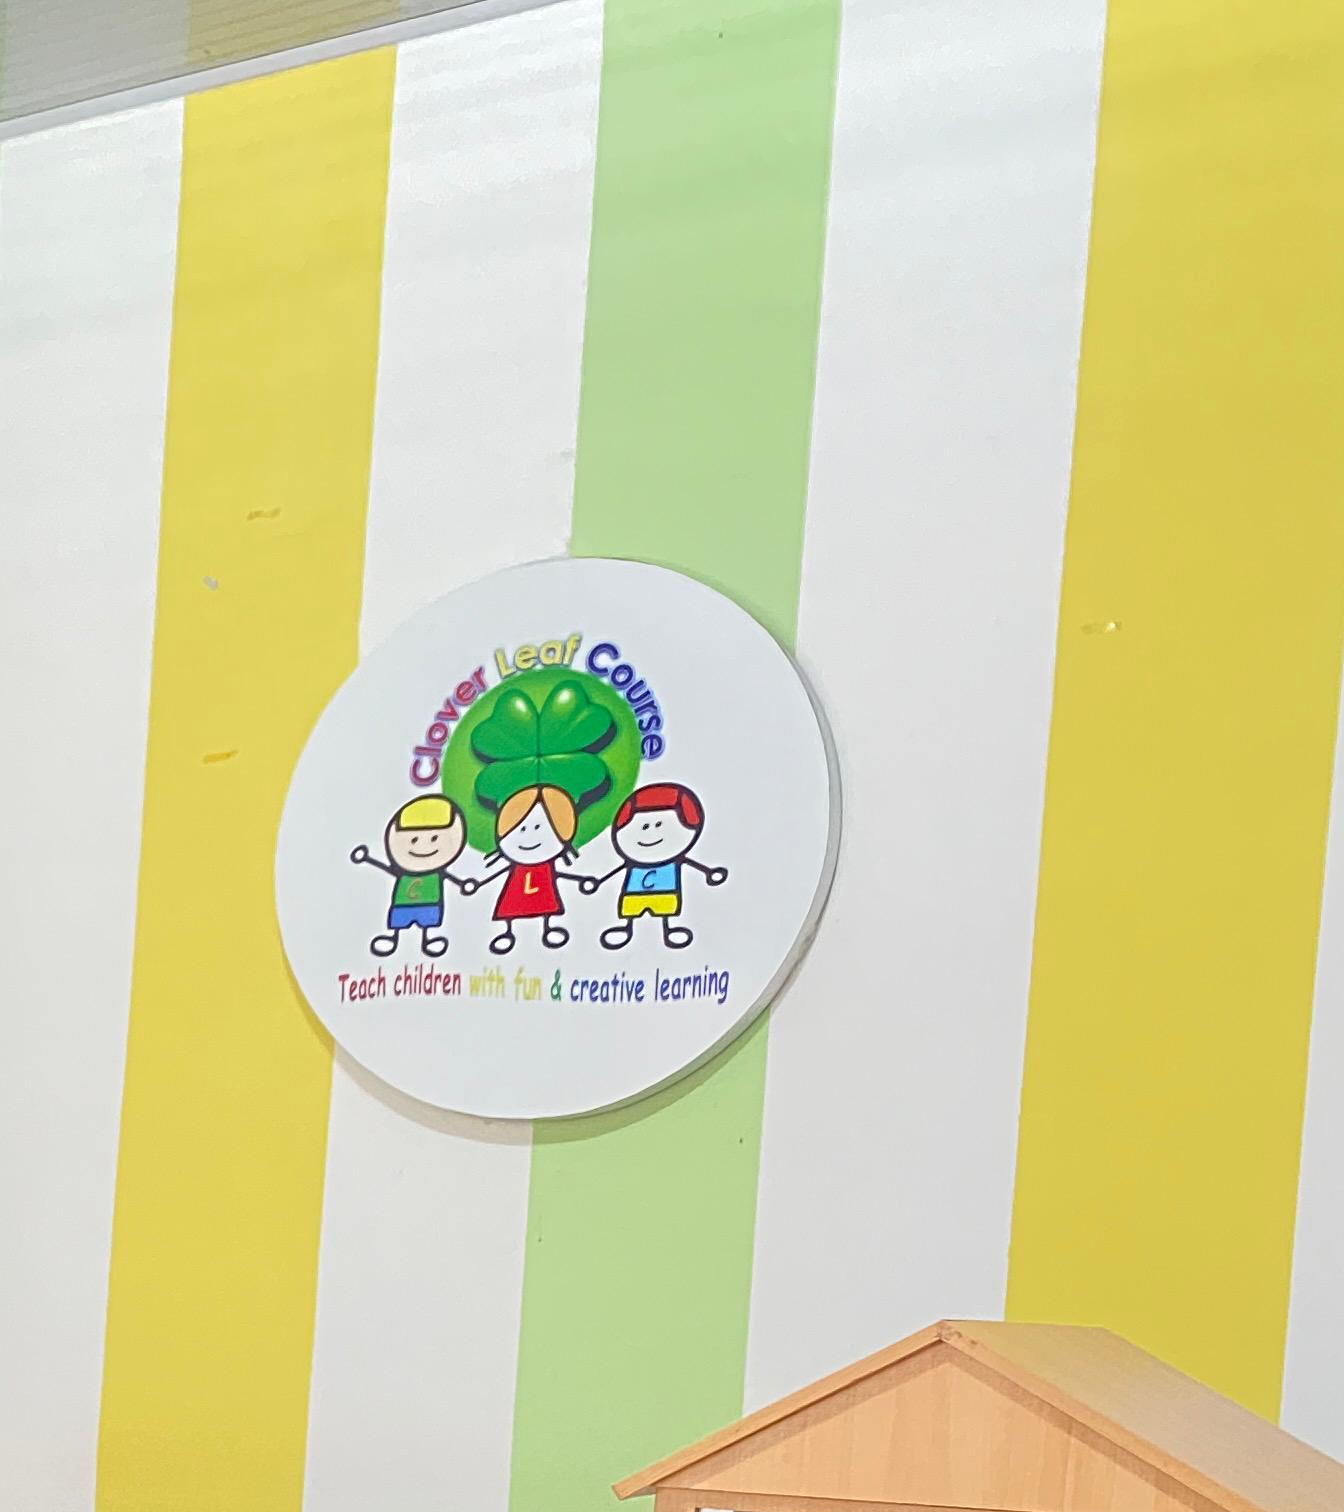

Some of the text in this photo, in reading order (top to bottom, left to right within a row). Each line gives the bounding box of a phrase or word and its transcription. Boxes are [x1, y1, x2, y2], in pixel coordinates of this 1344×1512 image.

[410, 633, 665, 787] Clover Leaf Course
[405, 879, 422, 899] C
[524, 872, 539, 895] L
[641, 870, 657, 889] C
[338, 963, 730, 1004] Teach children with fun & creative learning
